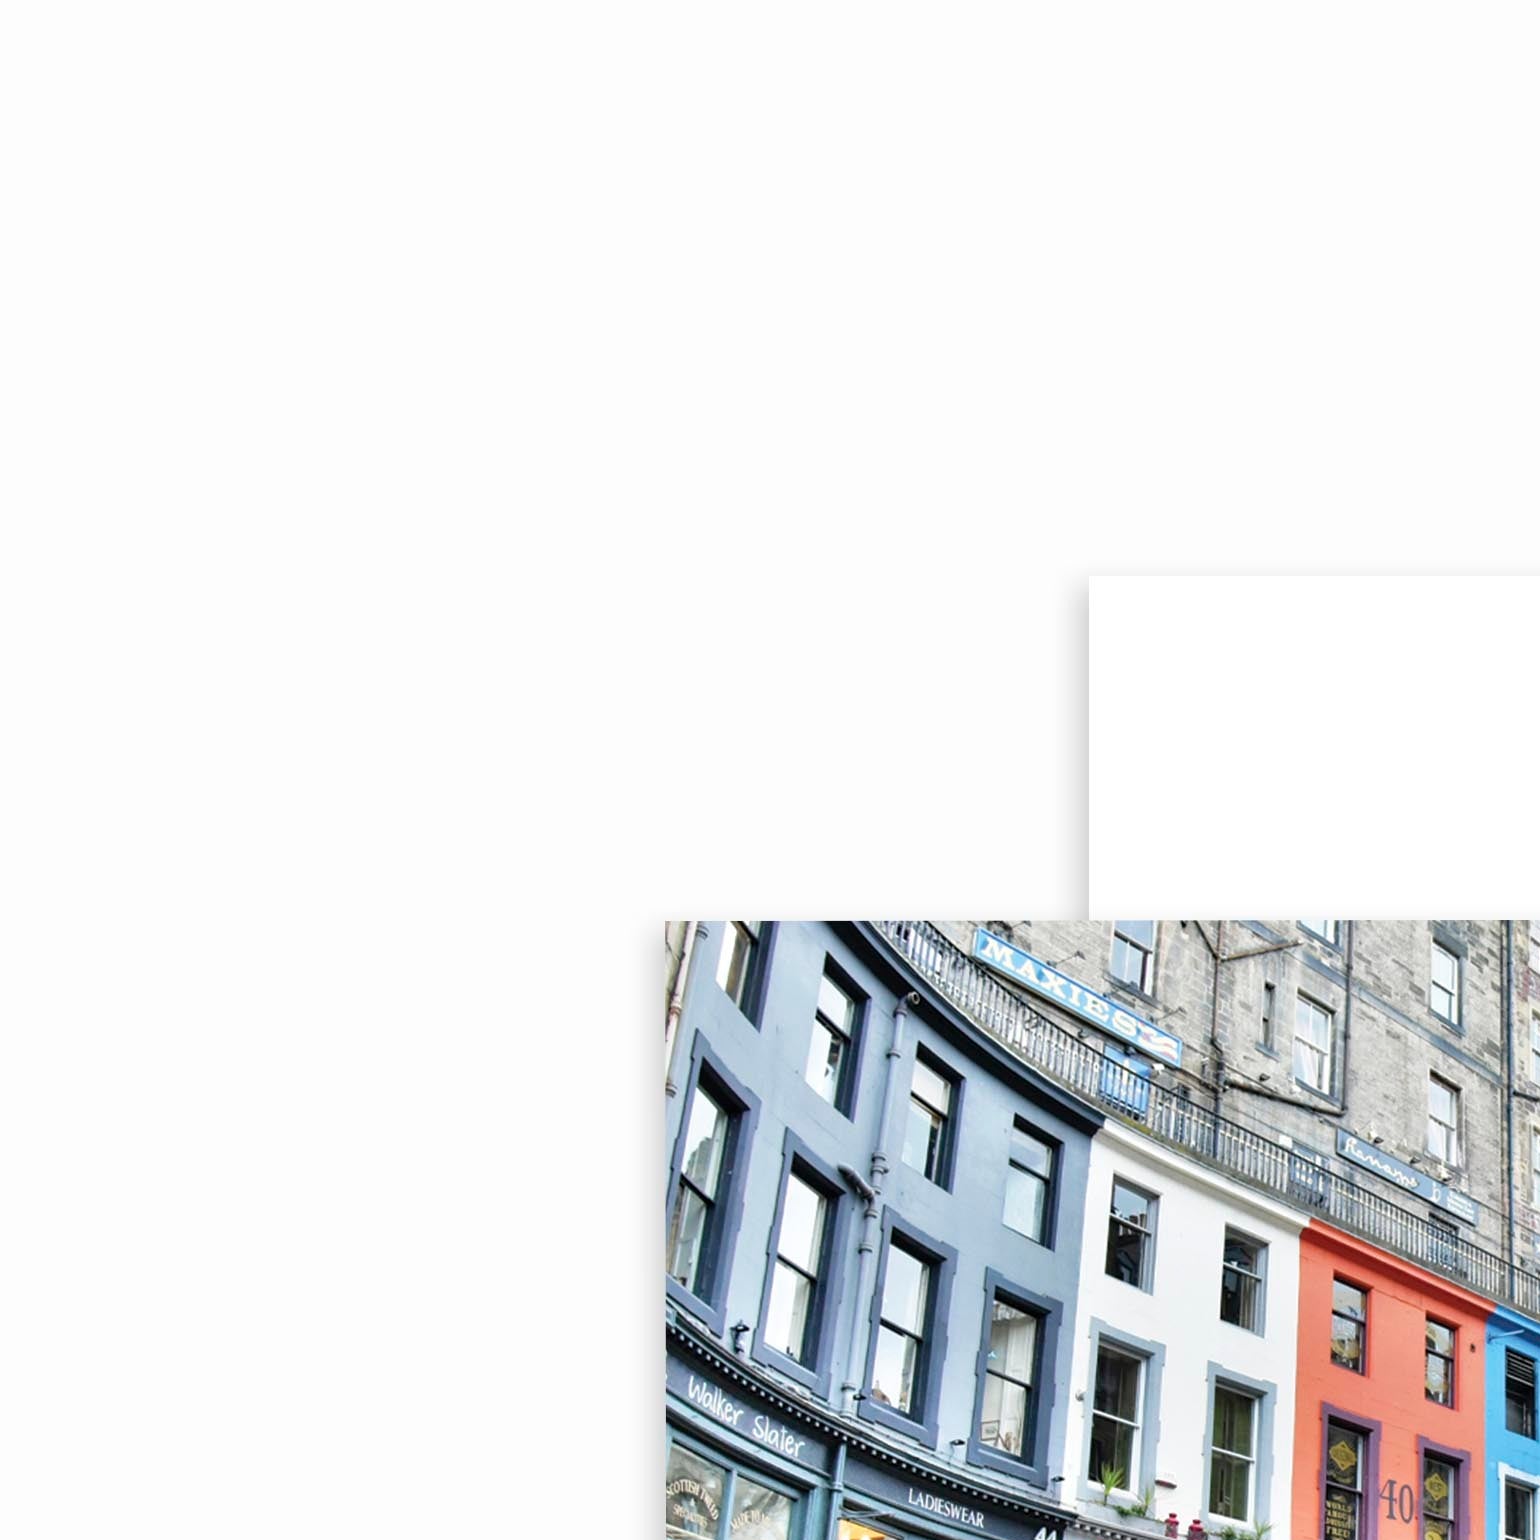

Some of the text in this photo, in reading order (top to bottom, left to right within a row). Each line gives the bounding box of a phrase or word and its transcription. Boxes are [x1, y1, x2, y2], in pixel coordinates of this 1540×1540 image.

[982, 936, 1137, 1037] MAXIES
[688, 1375, 805, 1458] Walker Slater
[908, 1487, 985, 1529] LADIESWEAR
[1379, 1479, 1414, 1524] 40
